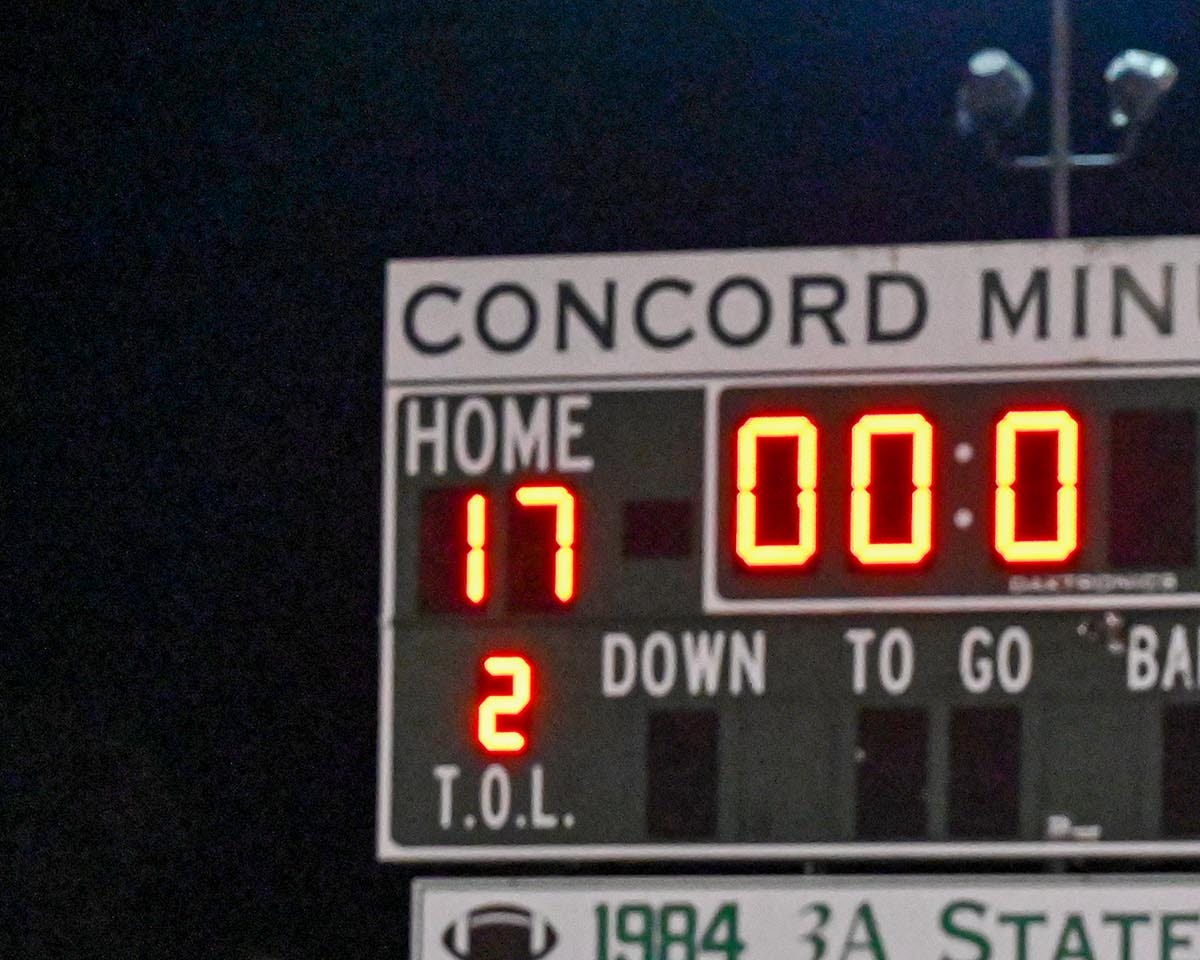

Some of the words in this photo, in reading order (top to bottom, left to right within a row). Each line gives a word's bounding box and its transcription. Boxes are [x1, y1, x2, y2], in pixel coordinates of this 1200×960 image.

[402, 271, 929, 355] CONCORD
[404, 394, 595, 476] HOME
[461, 484, 577, 606] 17
[601, 630, 767, 698] DOWN
[846, 628, 915, 694] TO
[958, 630, 1033, 693] GO
[477, 655, 532, 753] 2
[433, 764, 577, 831] T.O.L.
